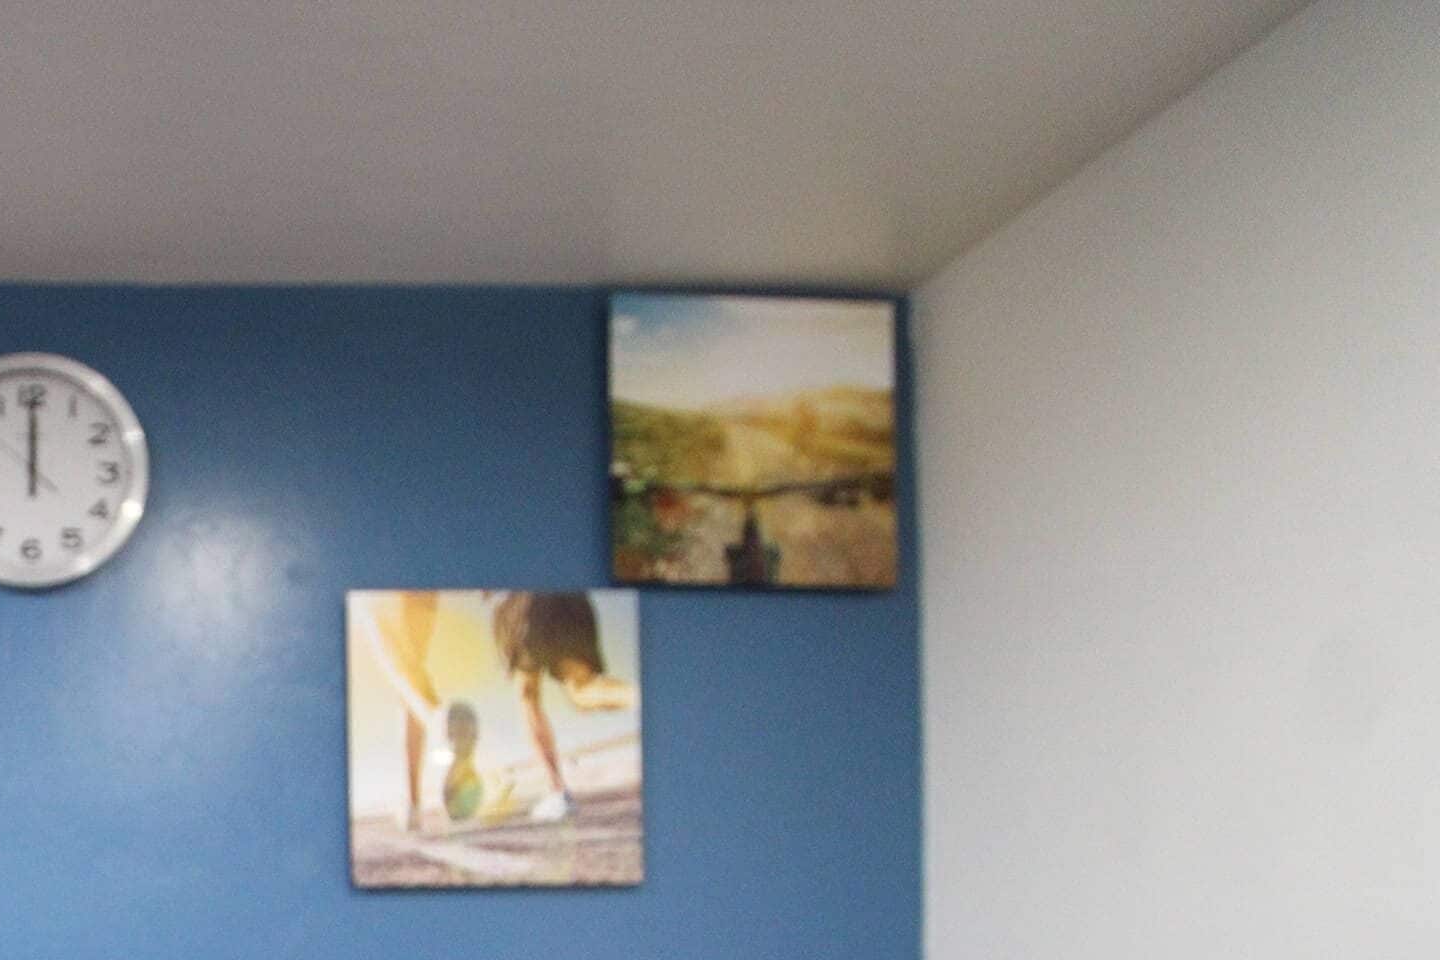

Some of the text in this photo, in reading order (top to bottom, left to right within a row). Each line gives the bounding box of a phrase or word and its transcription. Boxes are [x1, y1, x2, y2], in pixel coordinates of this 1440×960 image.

[17, 383, 46, 409] 12
[67, 395, 79, 418] 1
[88, 421, 111, 446] 2
[97, 460, 120, 485] 3
[87, 498, 109, 520] 4
[60, 526, 84, 549] 5
[19, 538, 43, 562] 6
